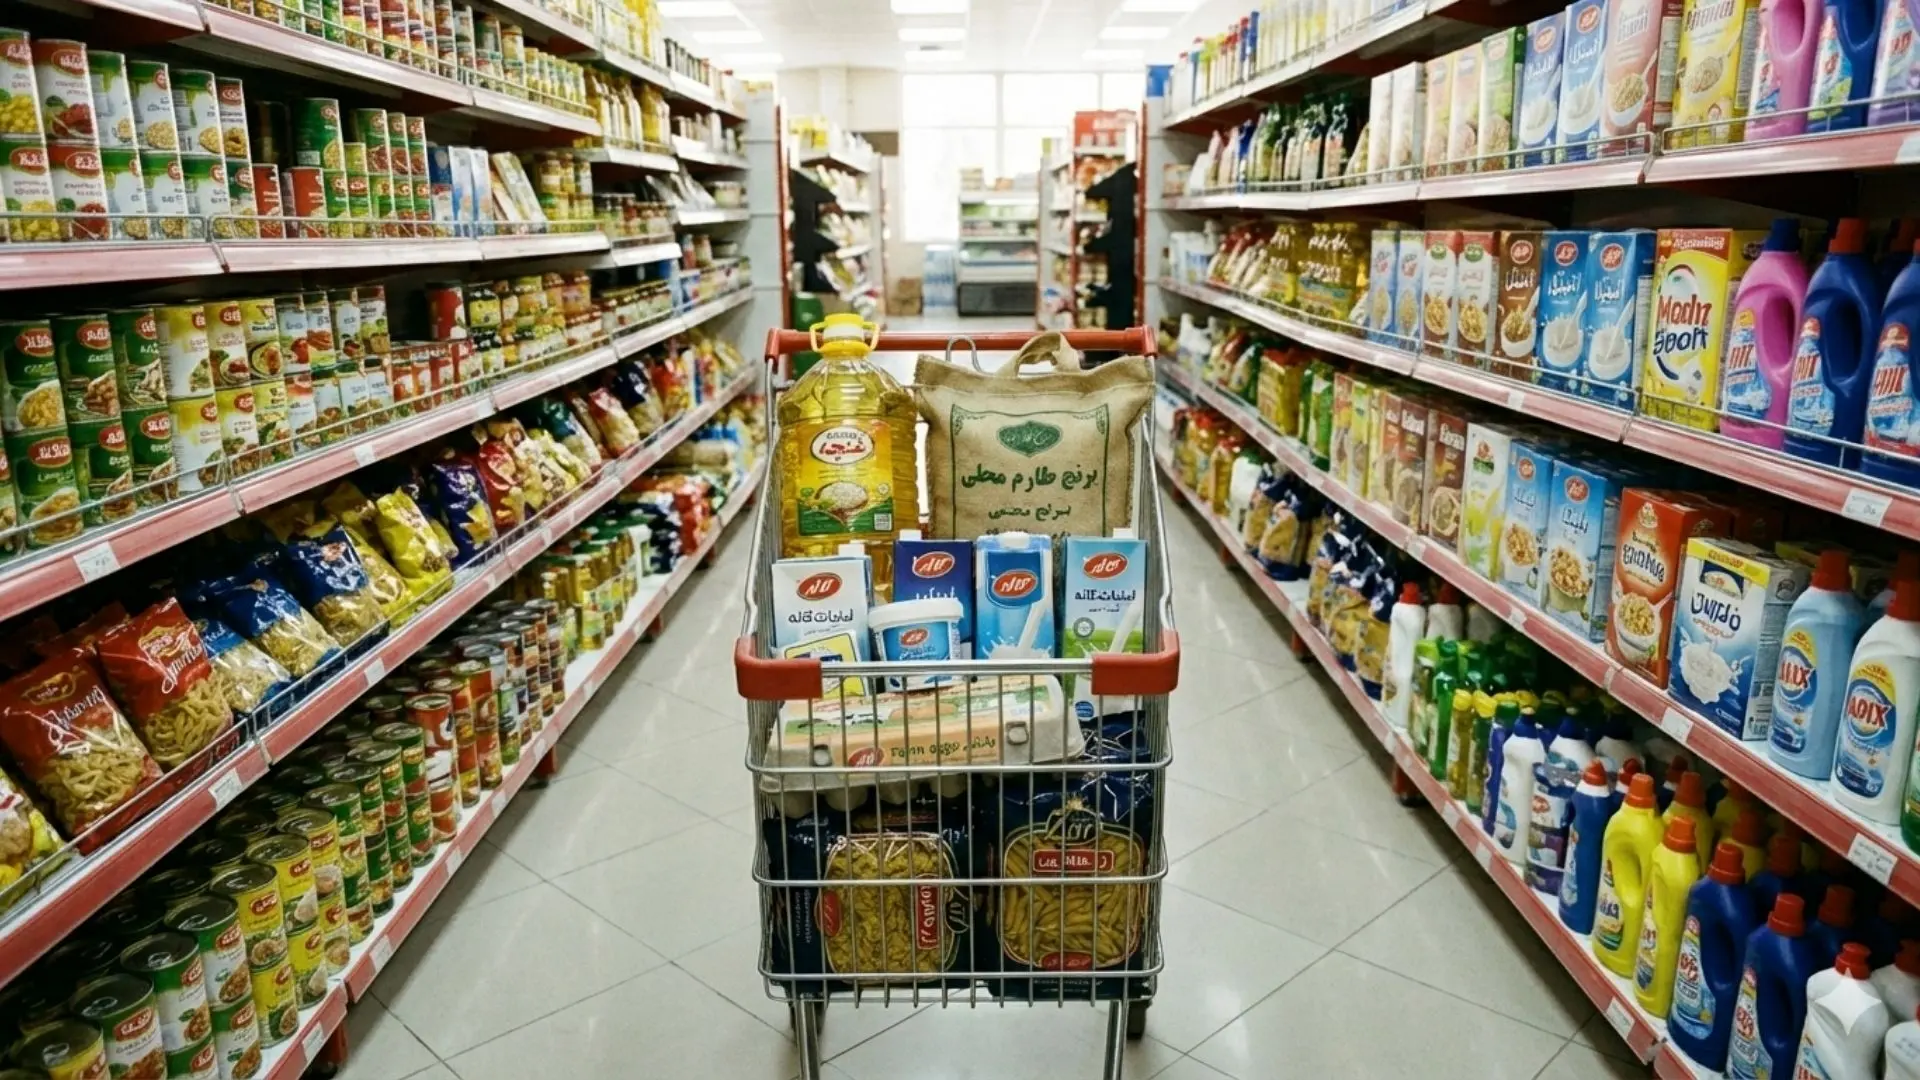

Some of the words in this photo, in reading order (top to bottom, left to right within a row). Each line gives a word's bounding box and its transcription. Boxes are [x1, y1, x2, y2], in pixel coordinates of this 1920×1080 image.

[961, 463, 1007, 488] محلی
[1012, 466, 1057, 492] طارم
[1061, 464, 1099, 490] برنج
